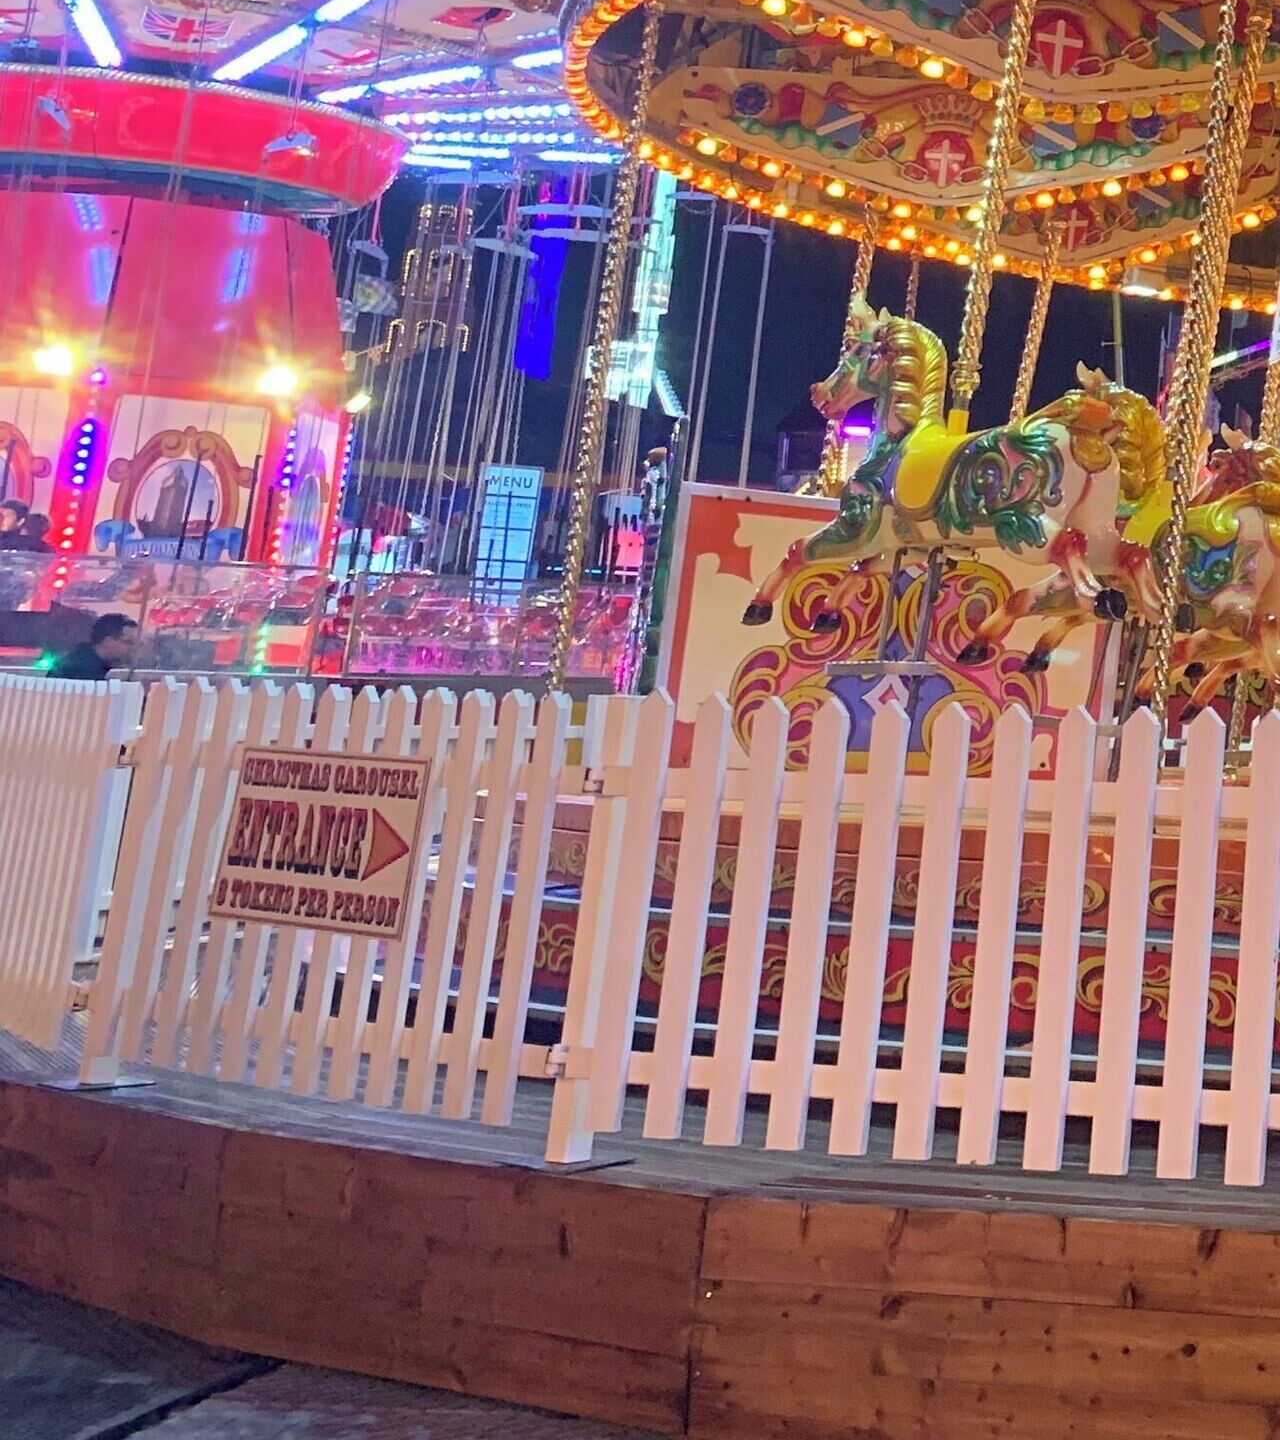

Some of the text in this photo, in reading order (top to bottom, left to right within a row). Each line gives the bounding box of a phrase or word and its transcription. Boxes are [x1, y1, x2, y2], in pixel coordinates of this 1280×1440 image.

[489, 474, 533, 489] MENU
[243, 756, 419, 800] CHRISTMAS CAROUSEL
[227, 797, 369, 880] ENTRANCE
[230, 878, 294, 916] TOKENS
[294, 885, 329, 919] PER
[329, 890, 400, 929] PERSON
